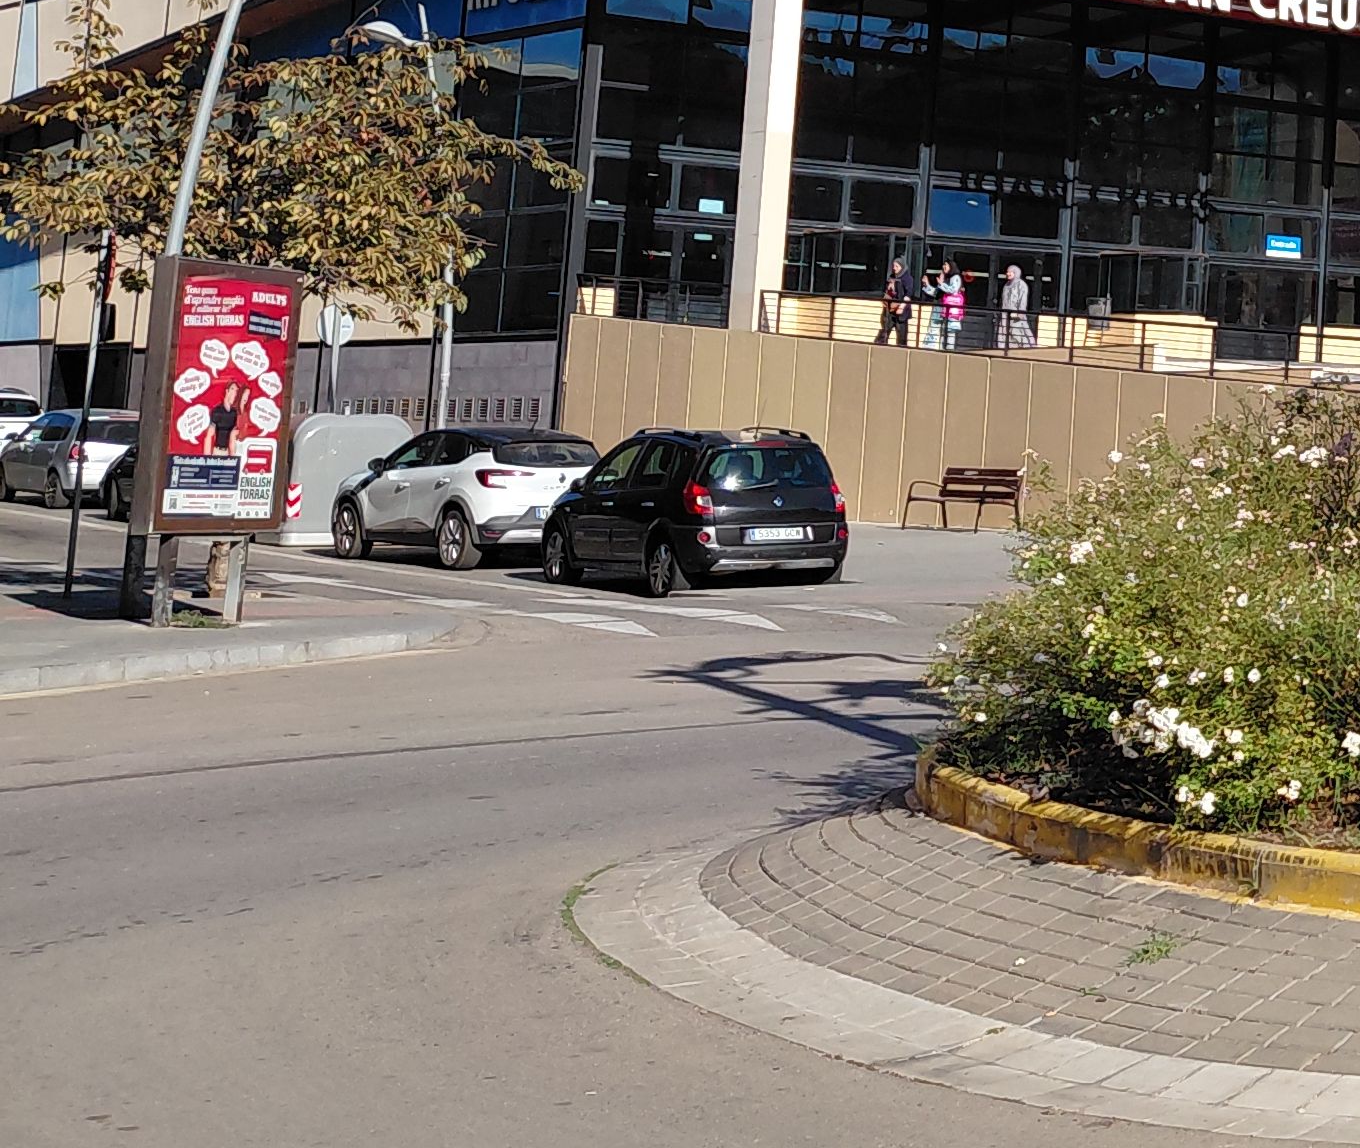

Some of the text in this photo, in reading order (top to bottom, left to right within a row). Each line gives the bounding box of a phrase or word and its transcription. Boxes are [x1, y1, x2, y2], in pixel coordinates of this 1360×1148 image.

[251, 291, 287, 307] ADULTS
[240, 476, 271, 488] ENGLISH
[239, 488, 270, 500] TORRAS
